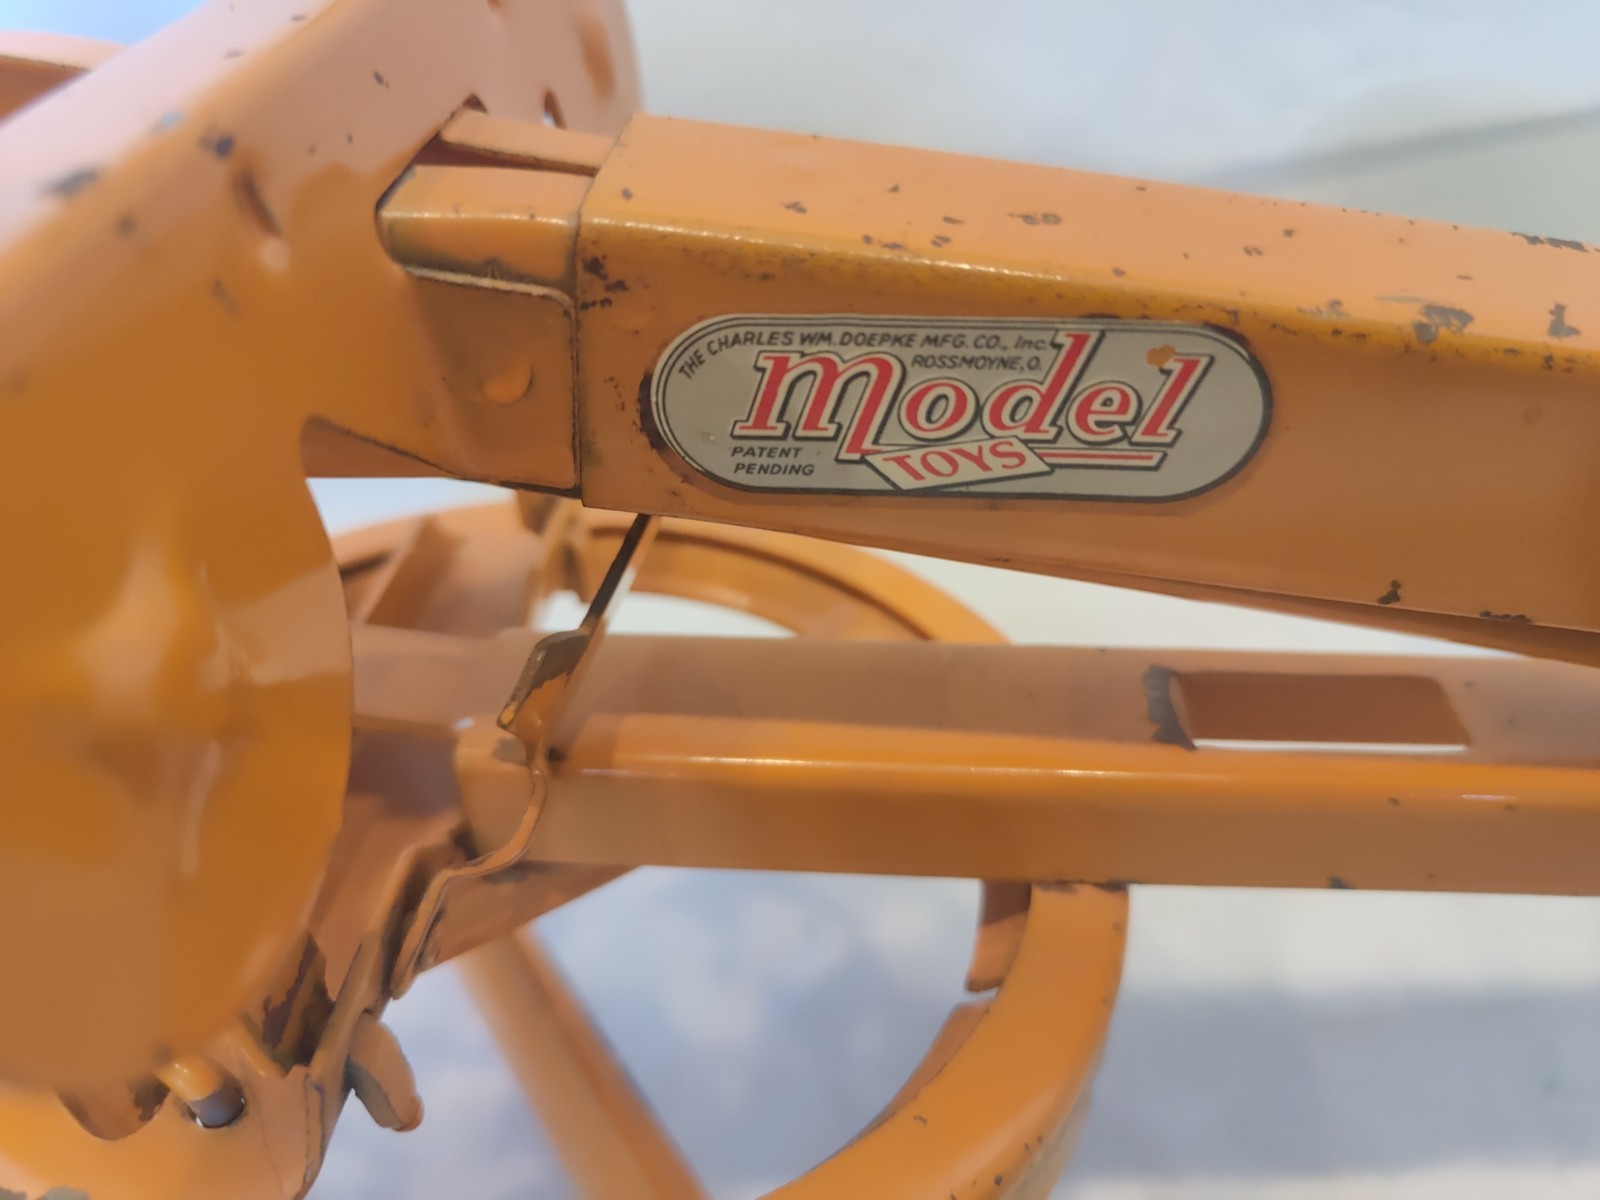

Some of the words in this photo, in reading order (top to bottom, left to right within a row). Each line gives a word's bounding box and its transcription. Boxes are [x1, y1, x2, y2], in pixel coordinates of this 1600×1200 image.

[678, 353, 706, 381] THE
[706, 331, 795, 356] CHARLES
[838, 332, 918, 348] DOEPKE
[920, 335, 970, 350] MFG.
[1014, 336, 1049, 350] Inc.
[730, 446, 803, 459] PATENT
[882, 440, 1027, 482] TOYS
[733, 461, 815, 477] PENDING
